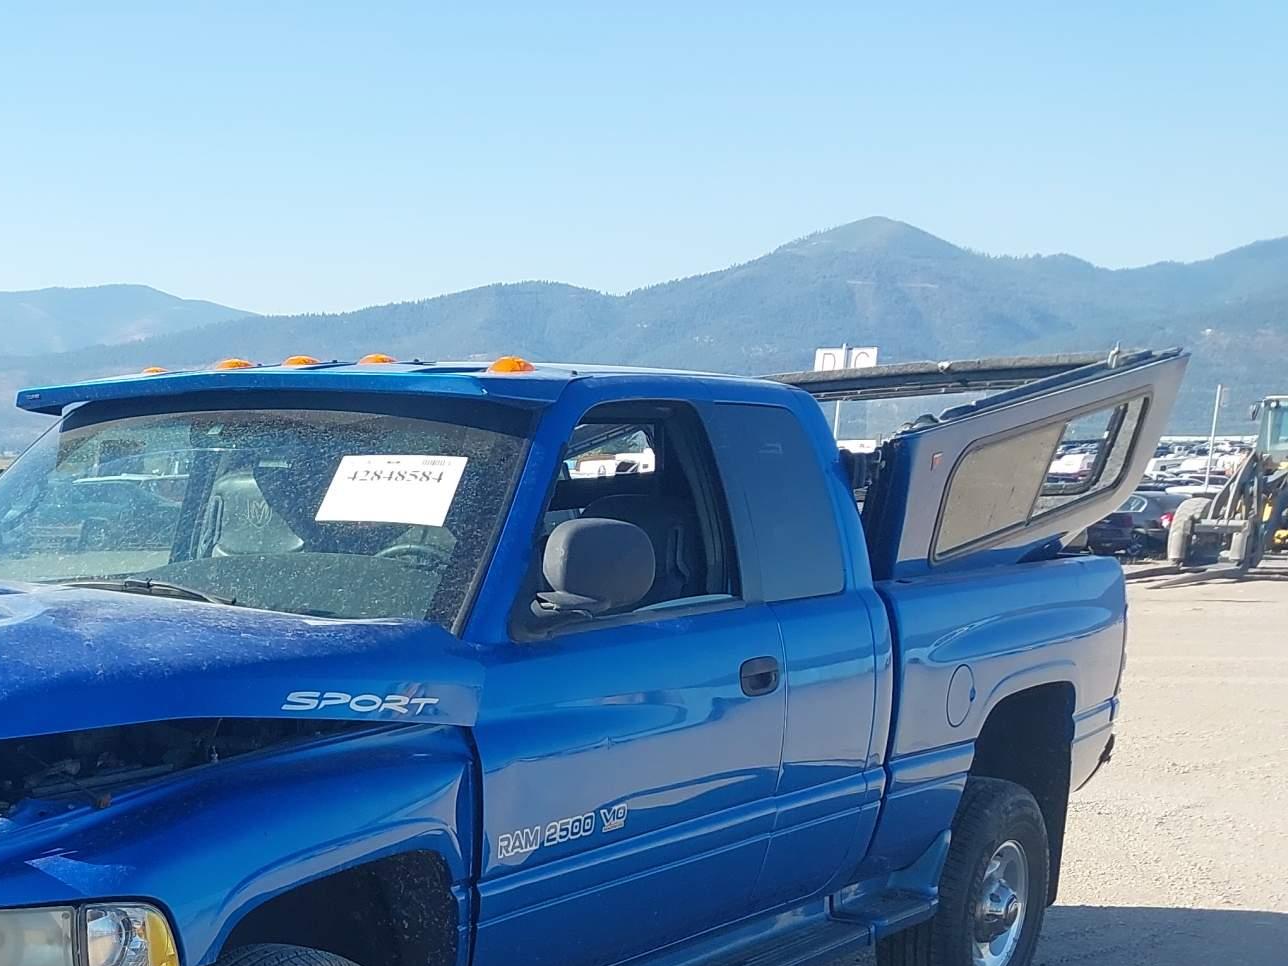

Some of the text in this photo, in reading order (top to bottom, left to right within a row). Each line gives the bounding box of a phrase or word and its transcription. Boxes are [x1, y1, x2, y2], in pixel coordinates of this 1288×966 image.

[347, 469, 444, 483] 42848584
[281, 691, 439, 715] SPORT
[498, 803, 628, 859] RAM 2500 V10
